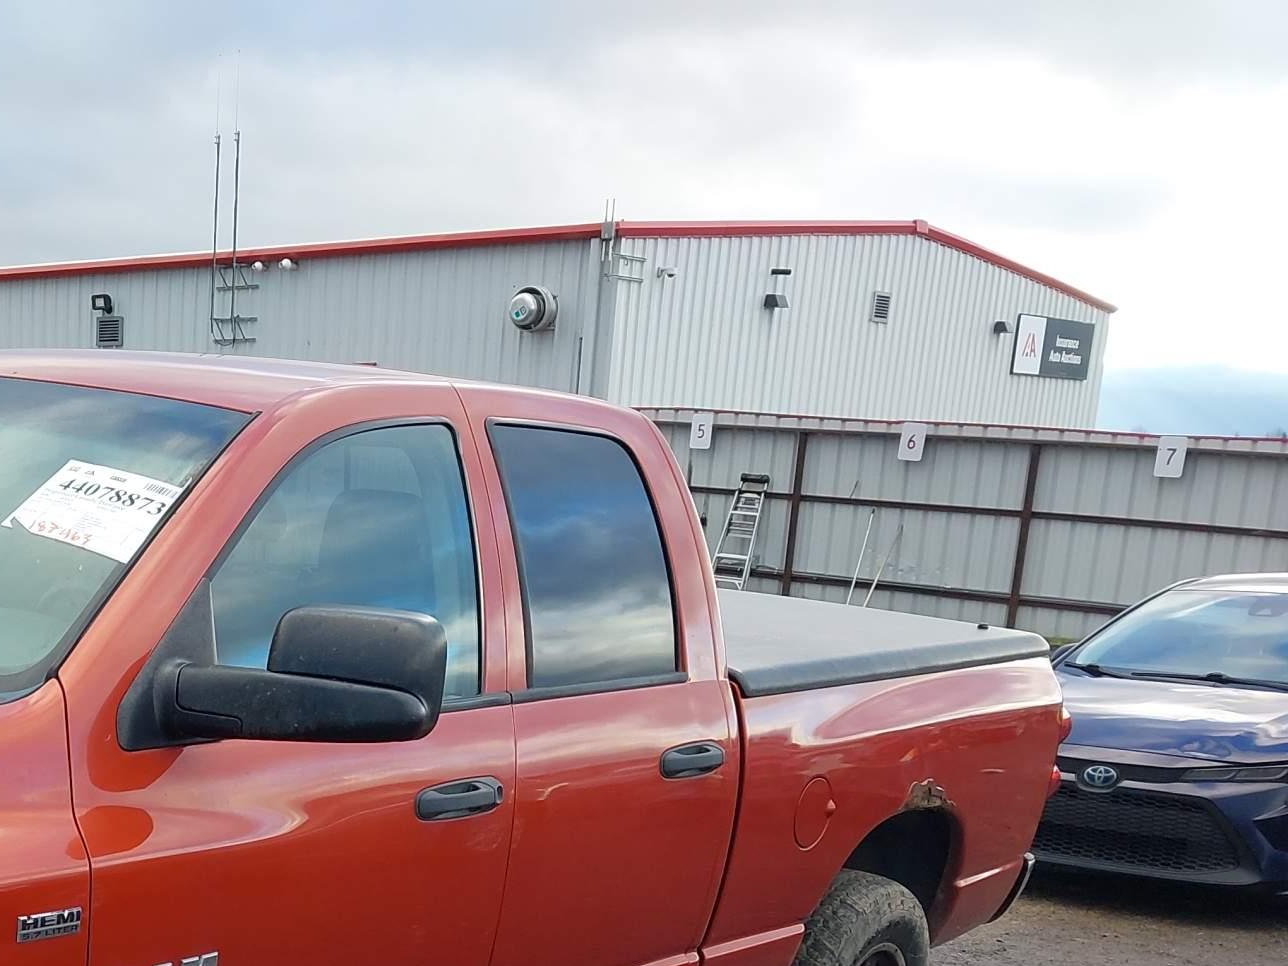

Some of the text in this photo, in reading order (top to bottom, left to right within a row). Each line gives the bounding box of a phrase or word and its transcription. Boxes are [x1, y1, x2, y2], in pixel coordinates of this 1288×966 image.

[697, 423, 706, 439] 5
[907, 433, 916, 450] 6
[1166, 447, 1177, 466] 7
[59, 478, 166, 516] 44078873
[17, 907, 81, 931] HEMI
[44, 923, 79, 937] LITER
